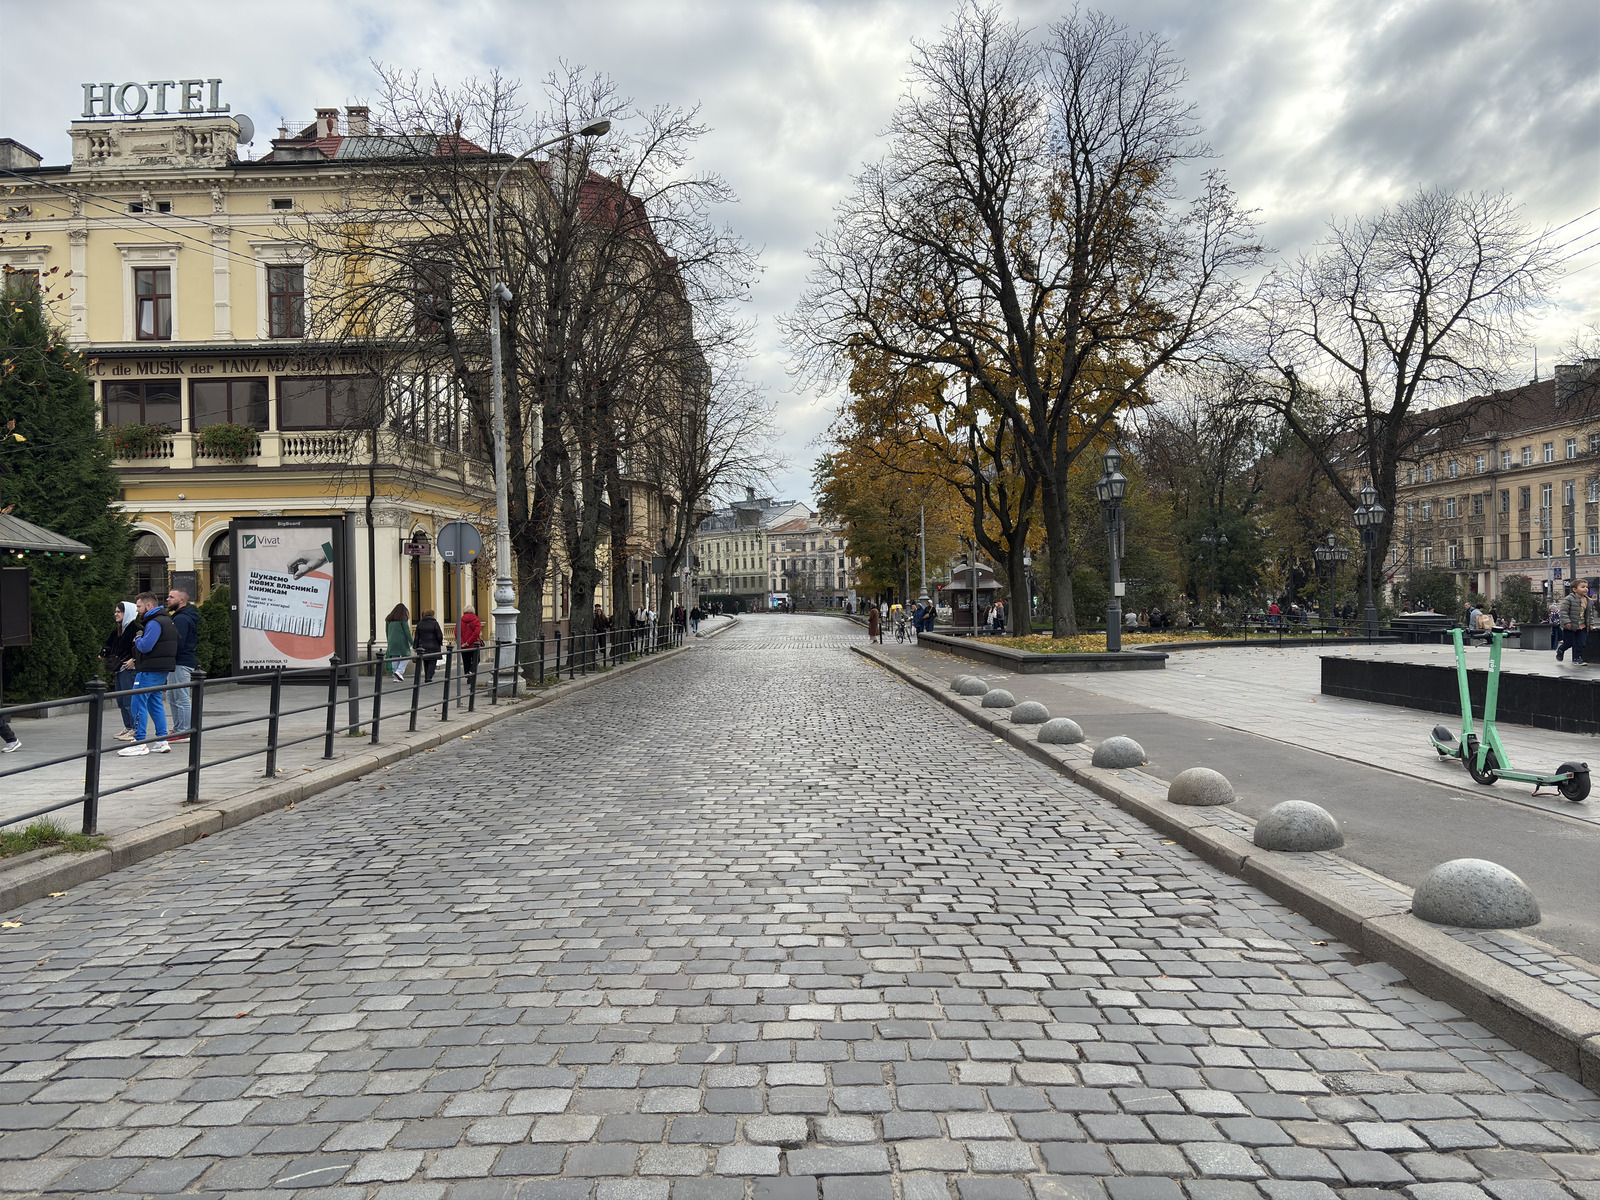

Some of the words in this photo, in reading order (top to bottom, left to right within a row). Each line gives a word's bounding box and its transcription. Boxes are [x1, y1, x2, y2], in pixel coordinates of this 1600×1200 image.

[81, 78, 230, 117] HOTEL
[112, 361, 132, 376] die
[190, 362, 214, 374] der
[219, 359, 261, 373] TANZ
[257, 535, 281, 545] Vivat
[250, 571, 289, 583] Шукаємо
[248, 585, 288, 596] книжкам
[249, 579, 275, 588] нових
[276, 583, 319, 594] власників
